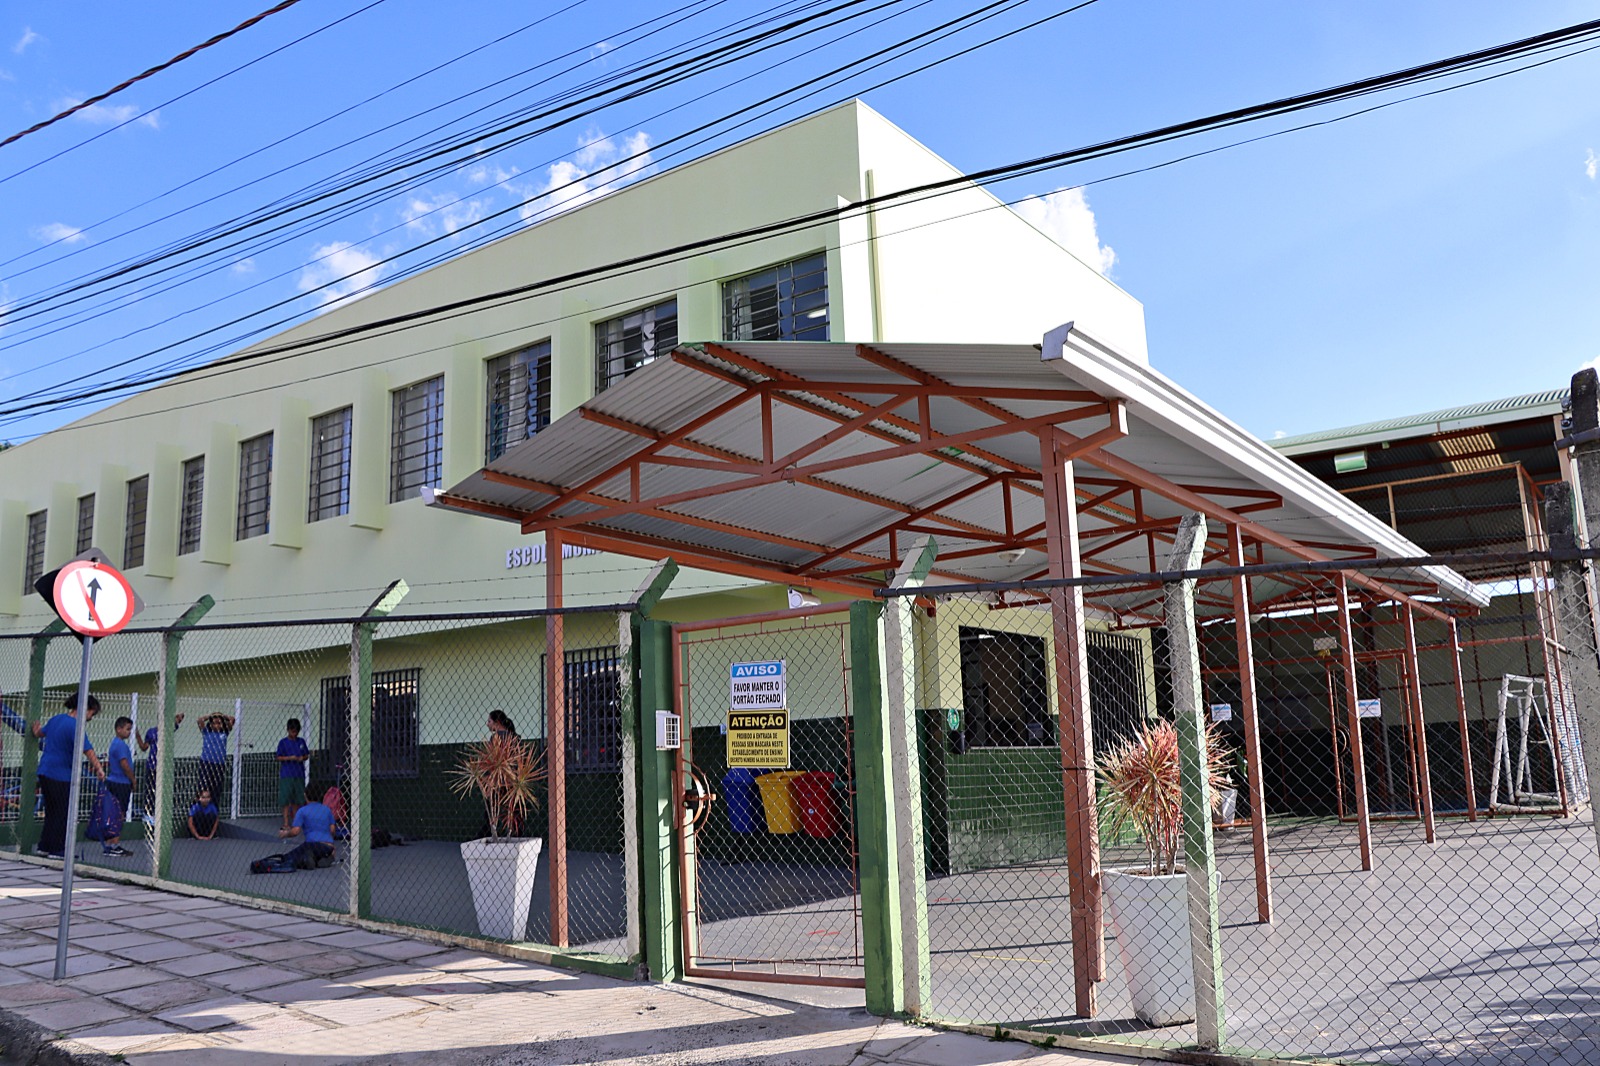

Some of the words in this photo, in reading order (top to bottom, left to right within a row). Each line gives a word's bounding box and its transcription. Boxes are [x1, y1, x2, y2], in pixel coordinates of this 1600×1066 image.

[505, 543, 547, 569] ESCOL
[736, 665, 777, 676] AVISO
[733, 683, 750, 692] FAVOR
[751, 681, 774, 691] MANTER
[775, 681, 779, 690] O
[733, 693, 754, 704] PORTÃO
[755, 693, 781, 703] FECHADO
[731, 714, 784, 729] ATENÇÃO
